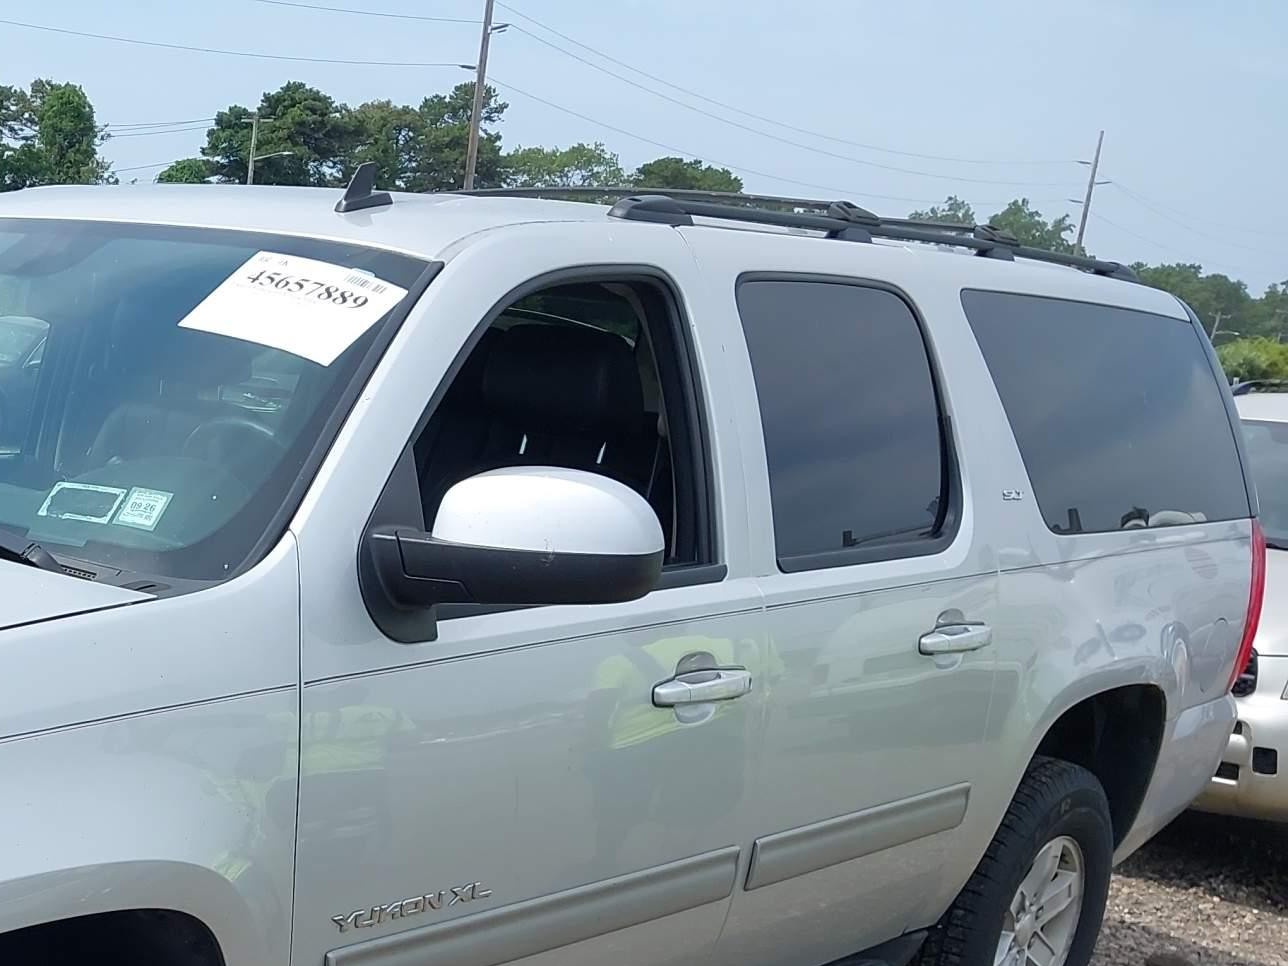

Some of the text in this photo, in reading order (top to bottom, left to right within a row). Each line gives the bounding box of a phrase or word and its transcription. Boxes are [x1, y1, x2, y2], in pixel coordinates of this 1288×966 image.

[247, 270, 369, 309] 45657889
[331, 882, 493, 933] YUKON XL
